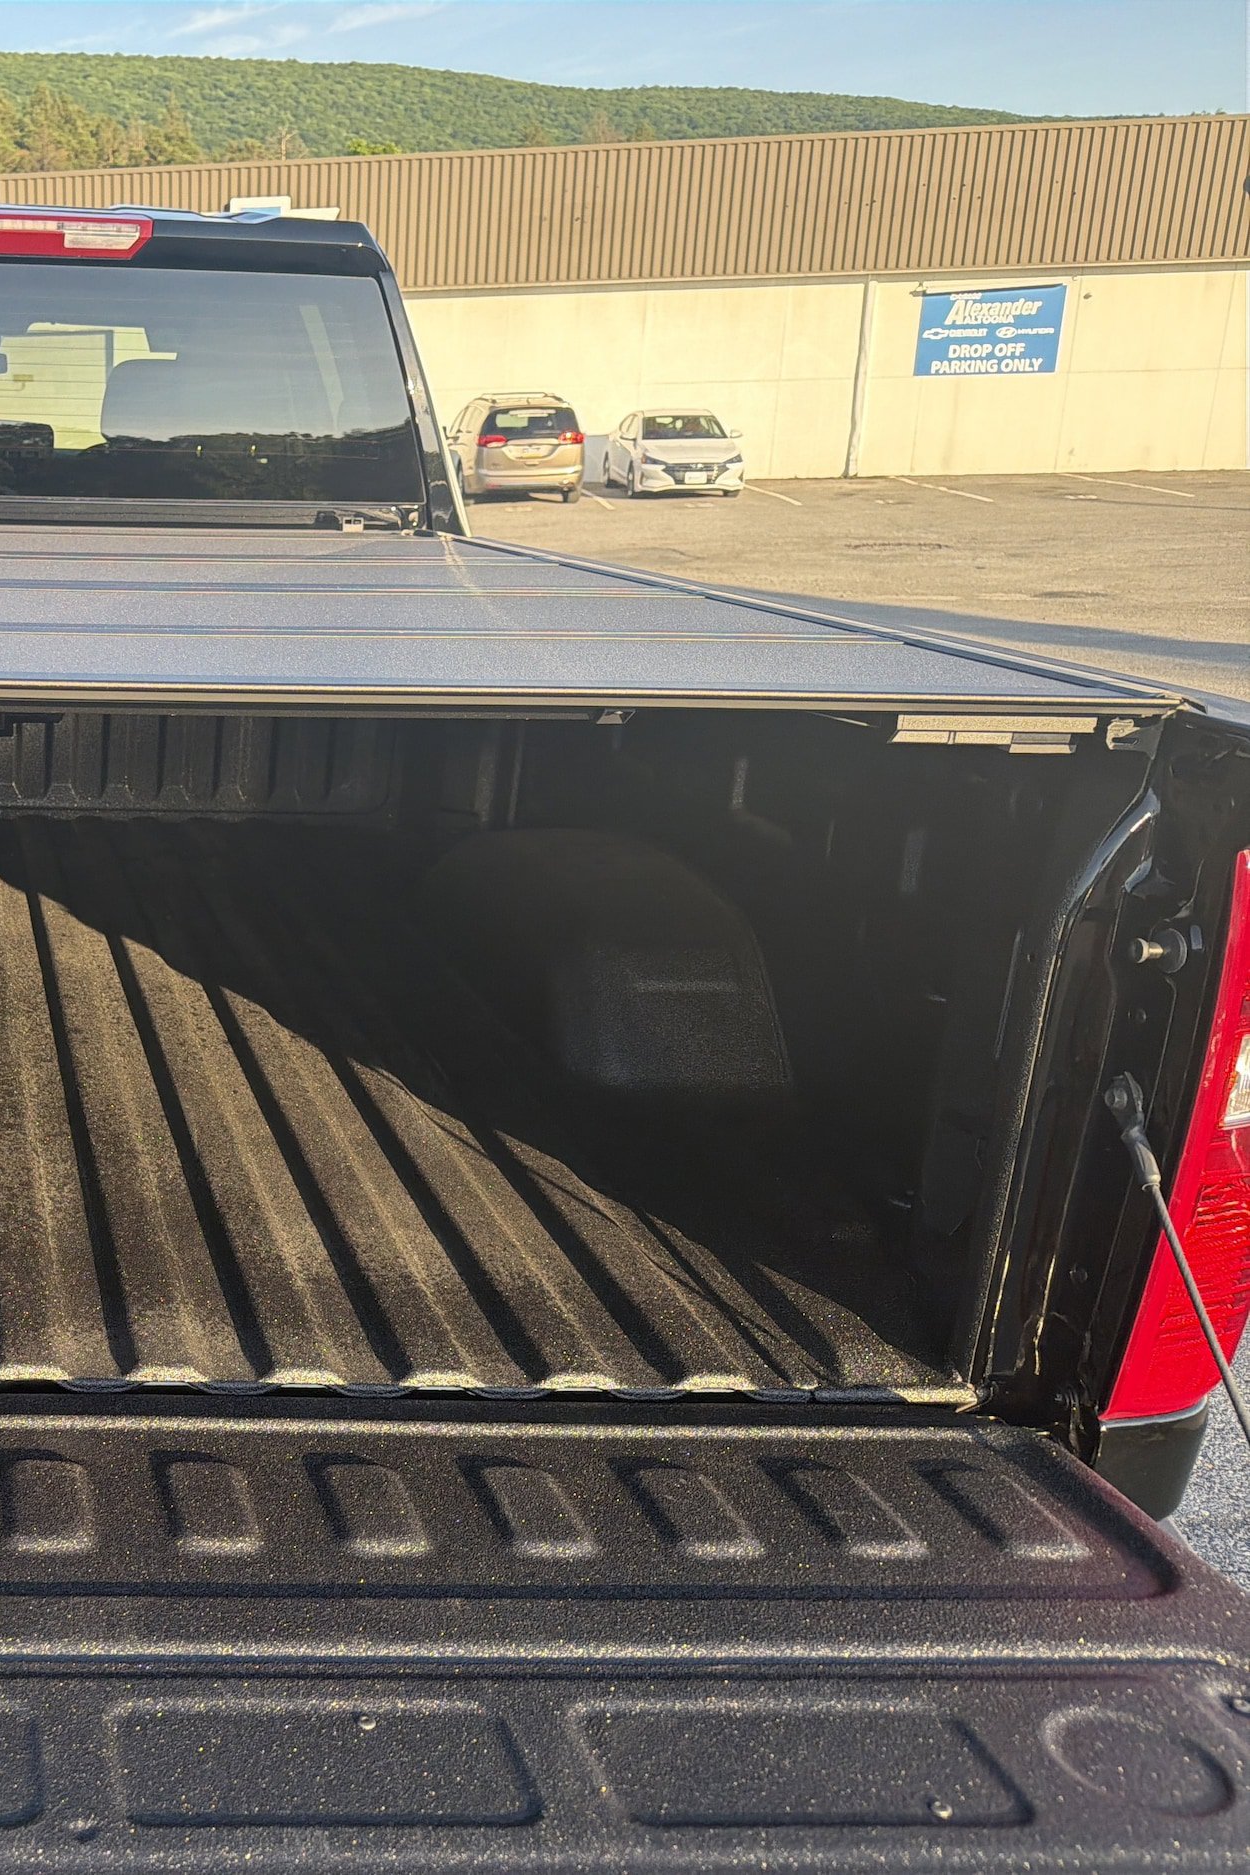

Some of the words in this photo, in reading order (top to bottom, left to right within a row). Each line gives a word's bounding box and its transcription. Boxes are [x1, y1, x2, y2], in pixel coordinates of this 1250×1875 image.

[944, 298, 1042, 325] Alexander
[948, 344, 992, 358] DROP
[994, 343, 1025, 357] OFF
[930, 360, 998, 374] PARKING
[1000, 358, 1043, 372] ONLY
